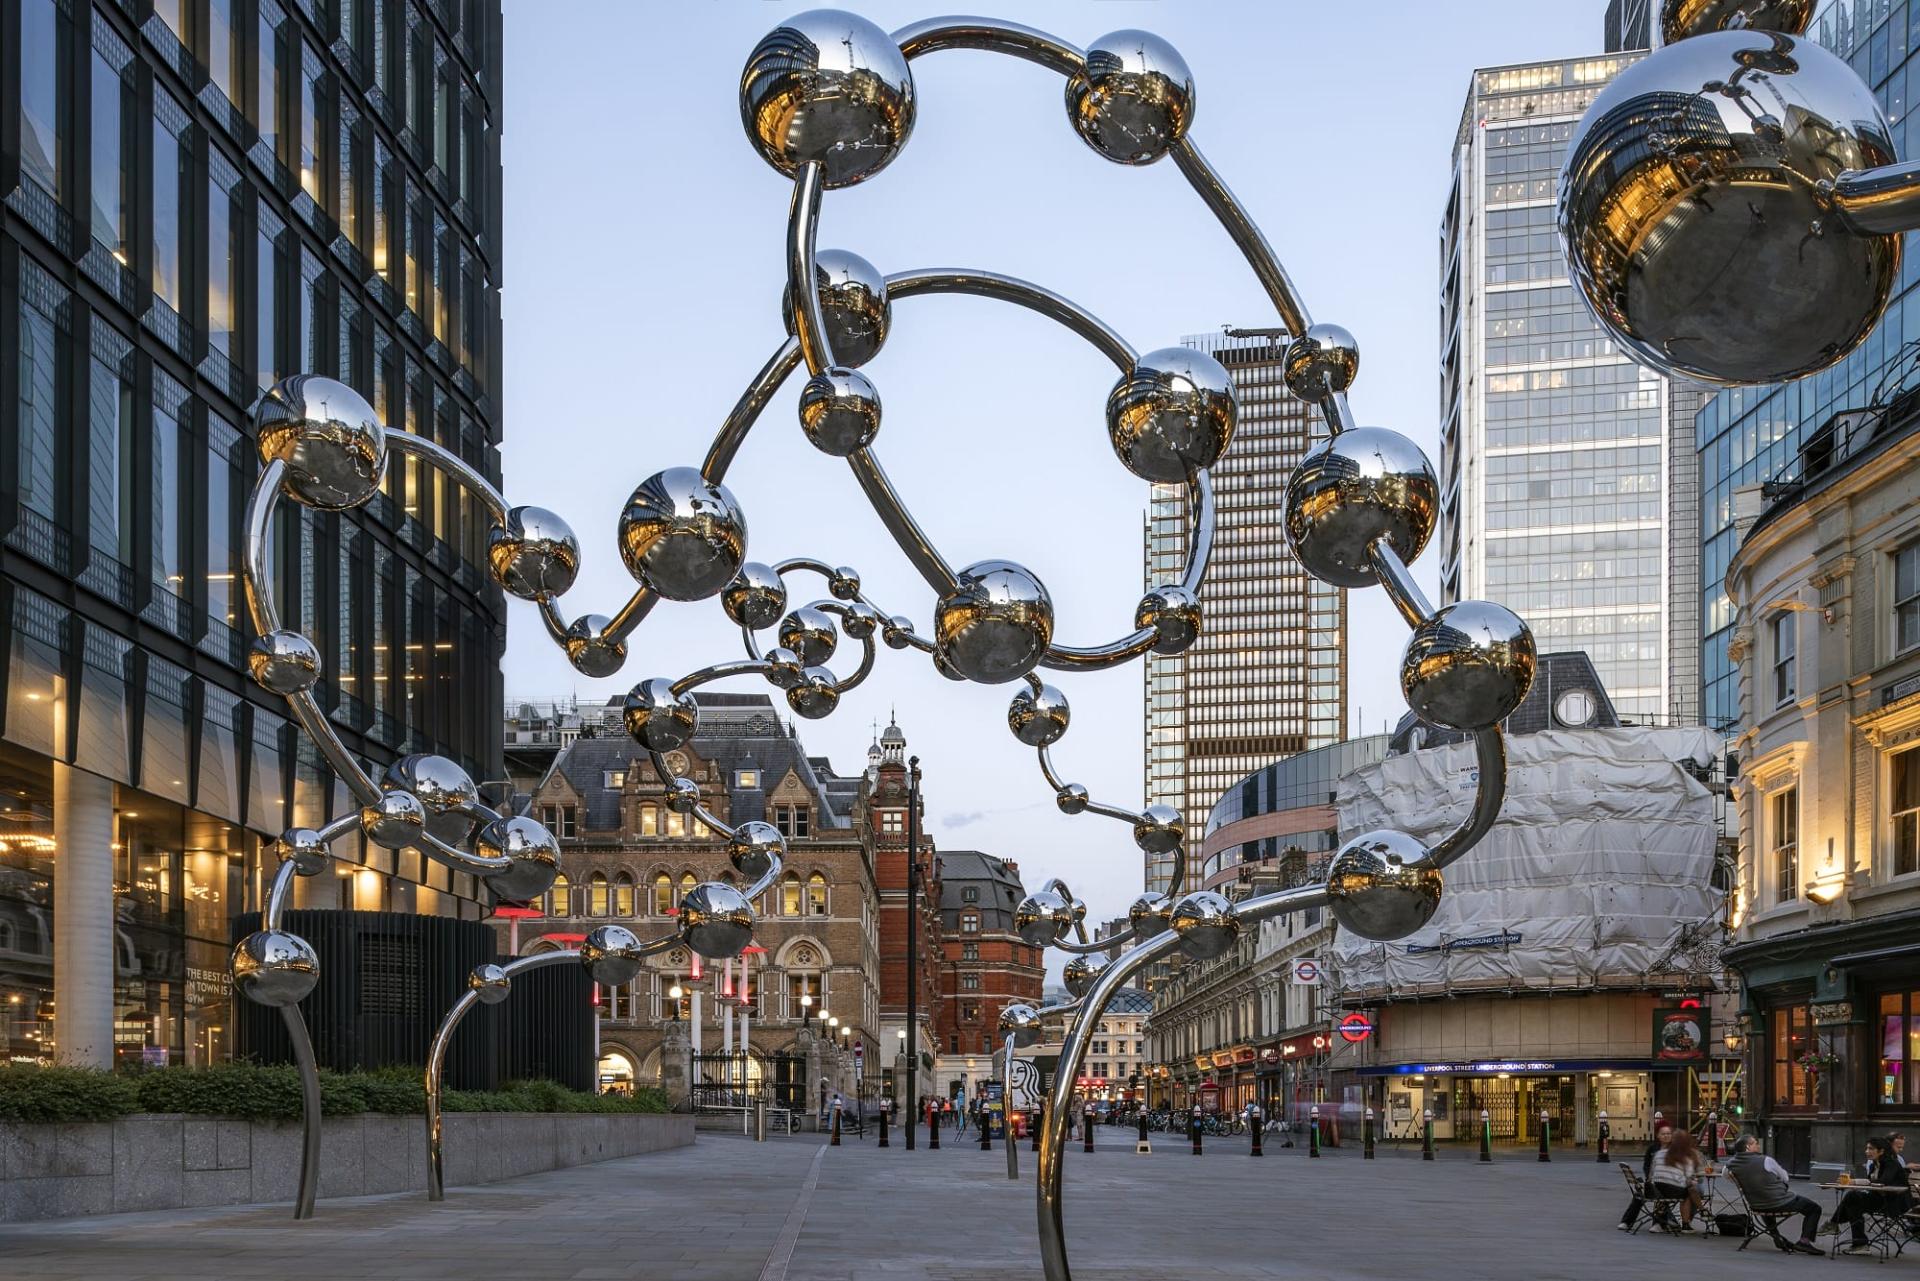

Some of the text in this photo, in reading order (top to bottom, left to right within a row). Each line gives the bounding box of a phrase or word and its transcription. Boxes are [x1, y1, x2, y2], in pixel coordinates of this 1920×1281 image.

[187, 968, 201, 979] THE
[203, 970, 220, 981] BEST
[197, 981, 219, 995] TOWN
[221, 985, 228, 995] IS
[187, 994, 204, 1004] GYM
